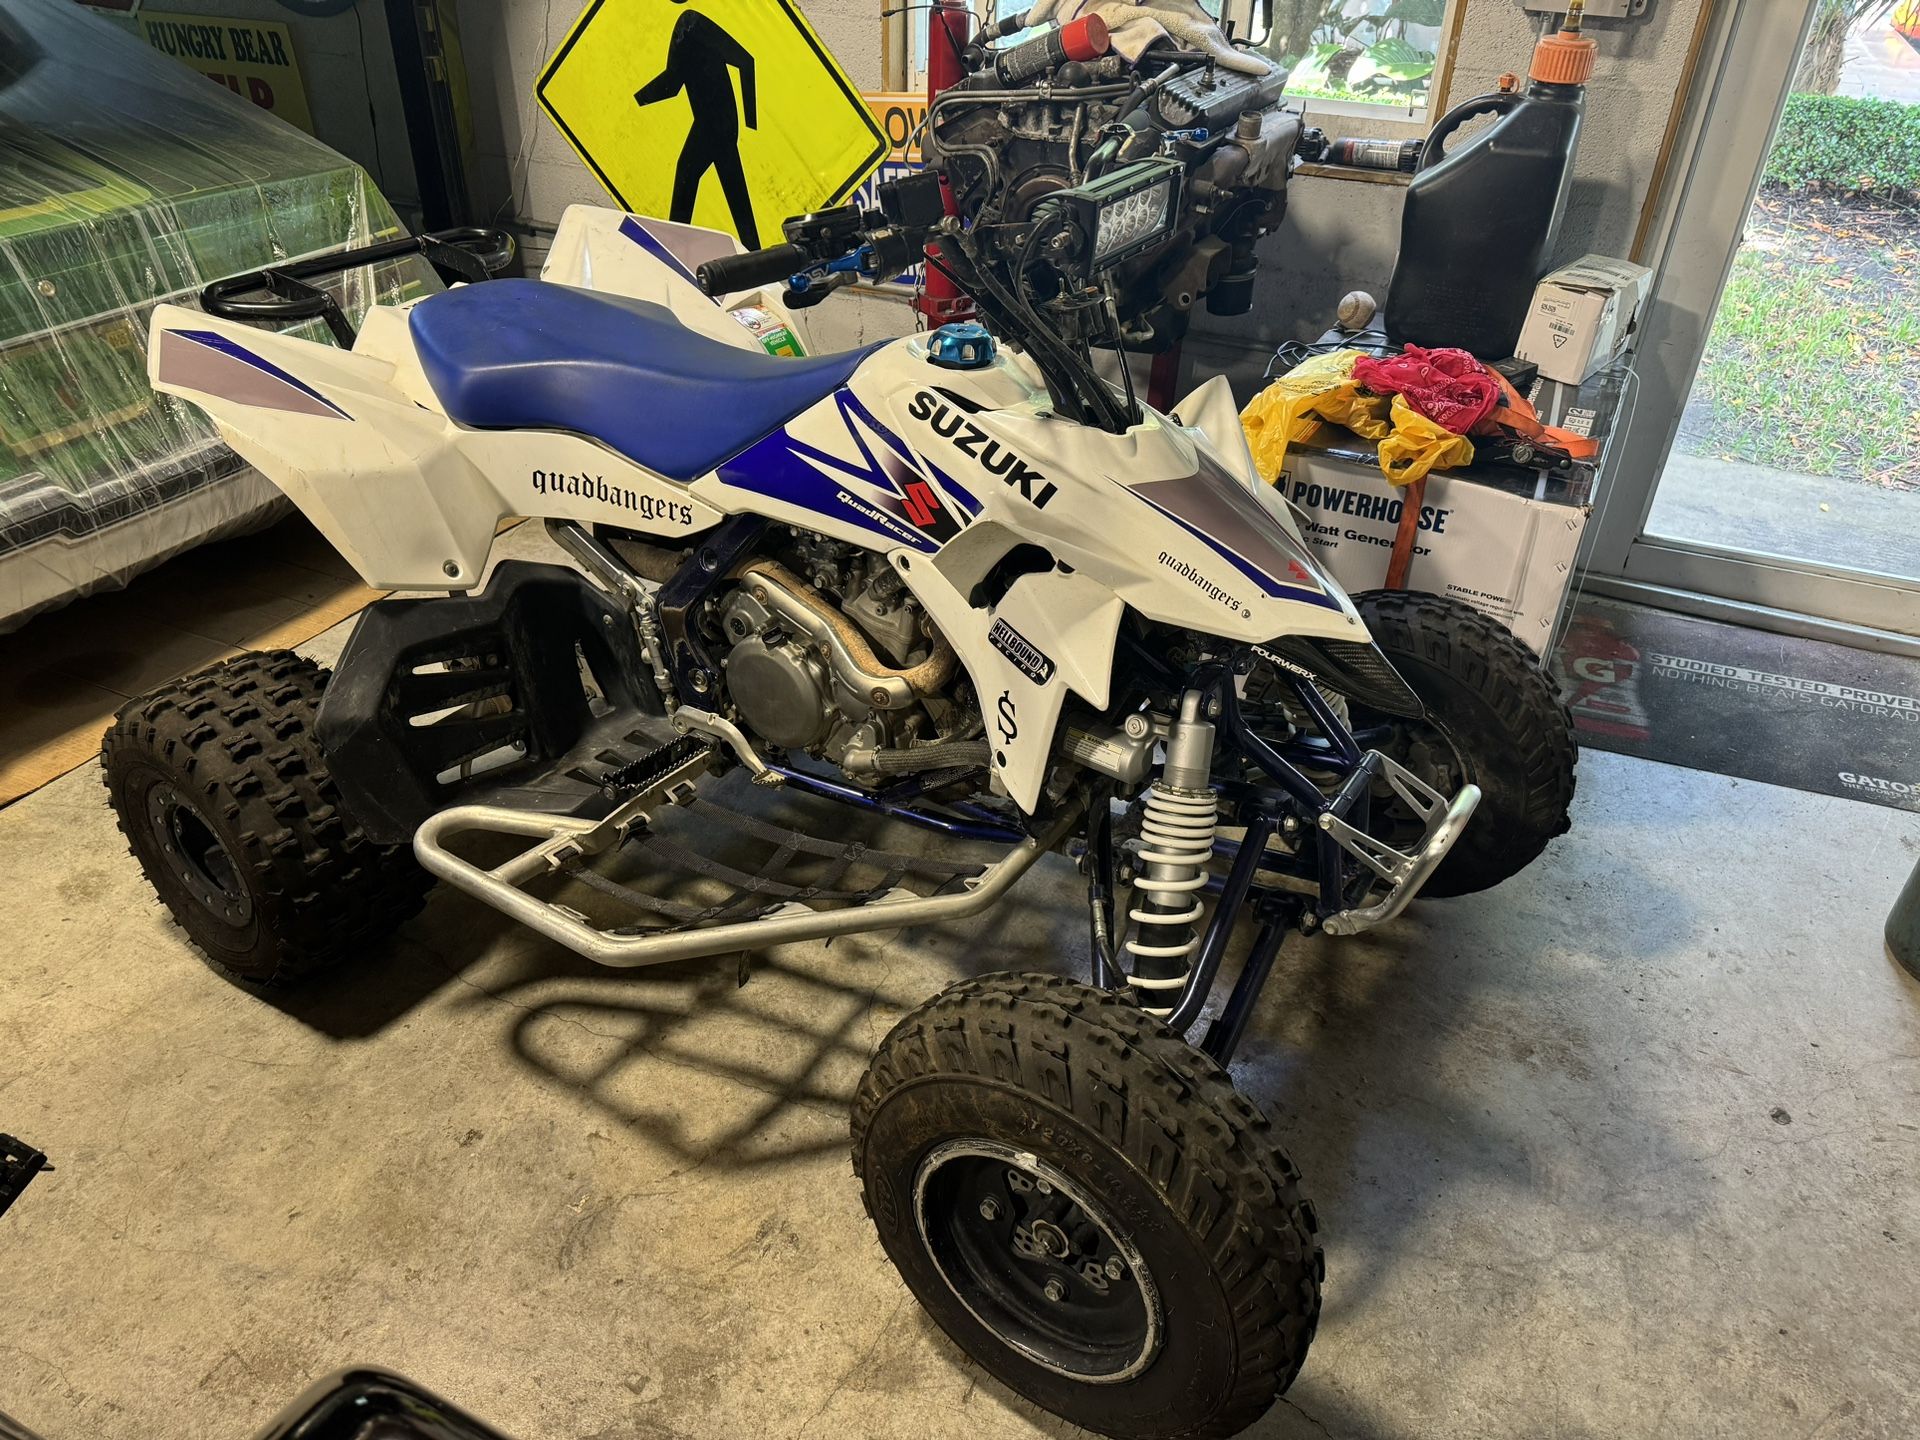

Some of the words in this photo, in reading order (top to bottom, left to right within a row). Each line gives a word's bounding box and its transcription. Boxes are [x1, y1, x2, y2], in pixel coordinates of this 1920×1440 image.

[145, 20, 227, 60] HUNGRY
[227, 27, 290, 67] BEAR
[884, 106, 928, 149] OW
[908, 391, 1058, 510] SUZUKI
[532, 469, 693, 526] quadbangers
[836, 490, 922, 545] QuadRacer
[1292, 482, 1449, 534] POWERHOSE
[1312, 537, 1339, 549] Start
[1344, 529, 1432, 557] Generor
[1158, 551, 1242, 611] quadbangers
[1446, 583, 1479, 597] STABLE
[993, 621, 1041, 669] HELLBOUND
[1251, 644, 1318, 681] FOURWERX
[1651, 653, 1741, 679] STUDIED.
[1747, 670, 1833, 695] TESTED.
[1652, 665, 1740, 690] NOTHING
[1746, 682, 1813, 704] BEATS
[1820, 695, 1920, 722] GATORAD
